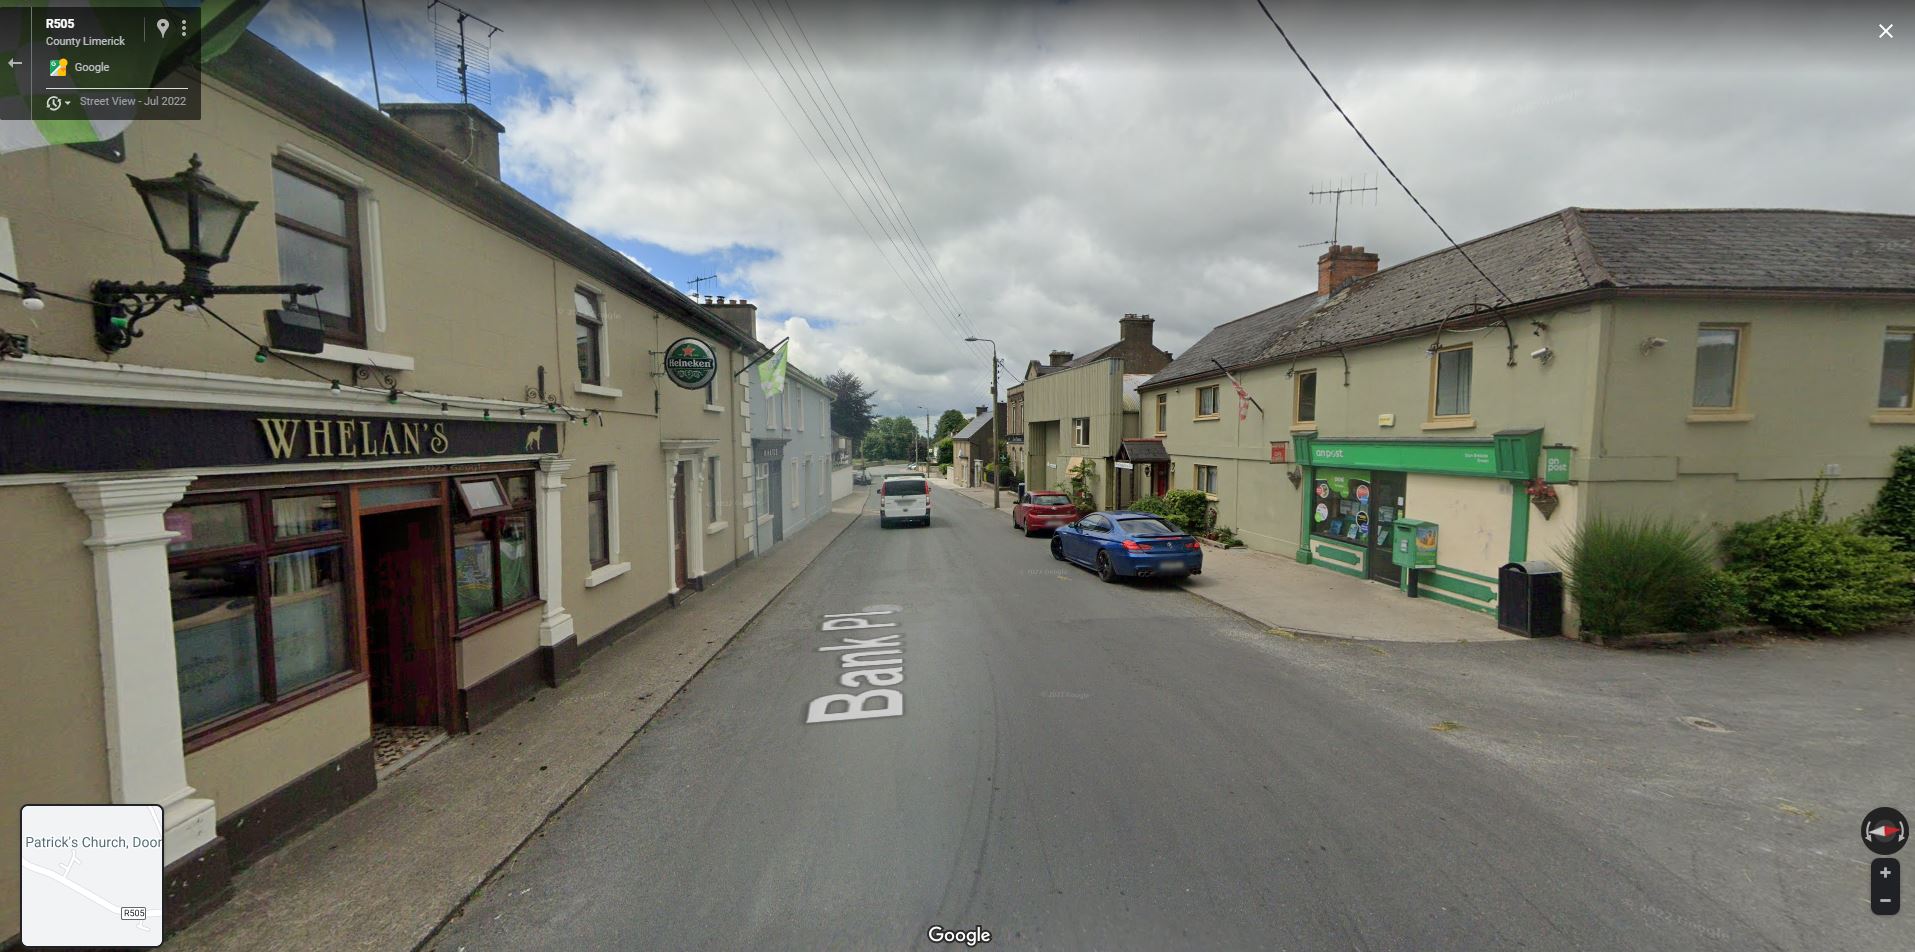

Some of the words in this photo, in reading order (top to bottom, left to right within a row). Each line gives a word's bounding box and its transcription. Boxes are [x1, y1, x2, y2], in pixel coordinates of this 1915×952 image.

[668, 358, 712, 368] Heineken
[256, 418, 449, 459] WHELAN'S
[1547, 464, 1568, 472] post
